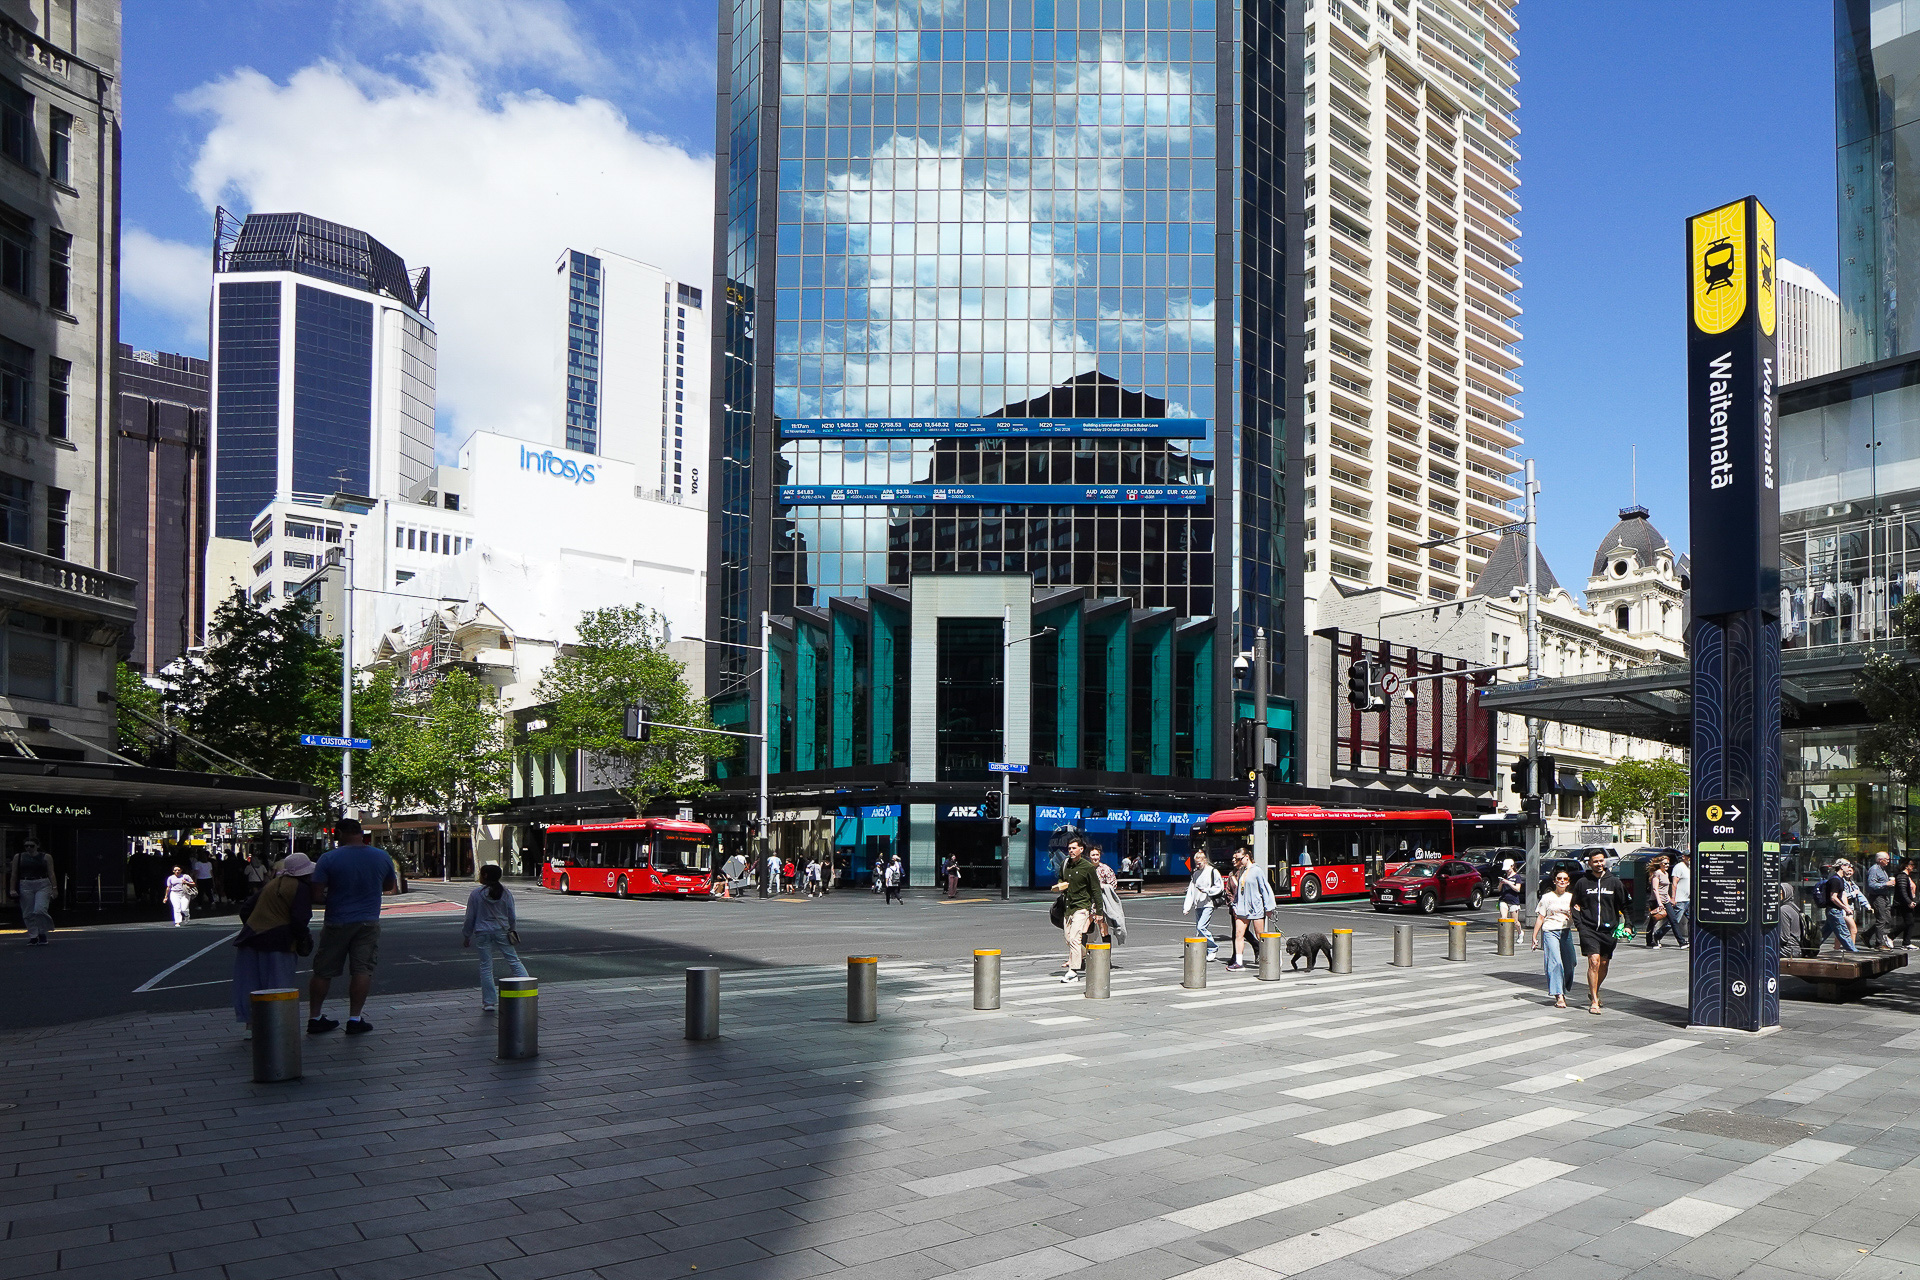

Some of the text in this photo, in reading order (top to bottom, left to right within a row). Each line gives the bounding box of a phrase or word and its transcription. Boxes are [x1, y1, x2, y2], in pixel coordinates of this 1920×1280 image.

[1709, 351, 1733, 490] Waitematā
[1763, 357, 1774, 490] Waitematā
[520, 444, 595, 486] Infosys
[320, 737, 352, 746] CUSTOMS
[9, 803, 92, 817] Van Cleef & Arpels
[872, 808, 884, 818] ANZ
[947, 806, 978, 818] ANZ
[1040, 809, 1058, 818] ANZ
[159, 811, 174, 820] Van
[176, 812, 198, 820] Cleef
[206, 813, 232, 822] Arpels
[1107, 812, 1123, 820] ANZ
[1138, 814, 1154, 822] ANZ
[1167, 815, 1182, 823] ANZ
[1712, 825, 1734, 834] 60m
[1424, 851, 1441, 859] Metro
